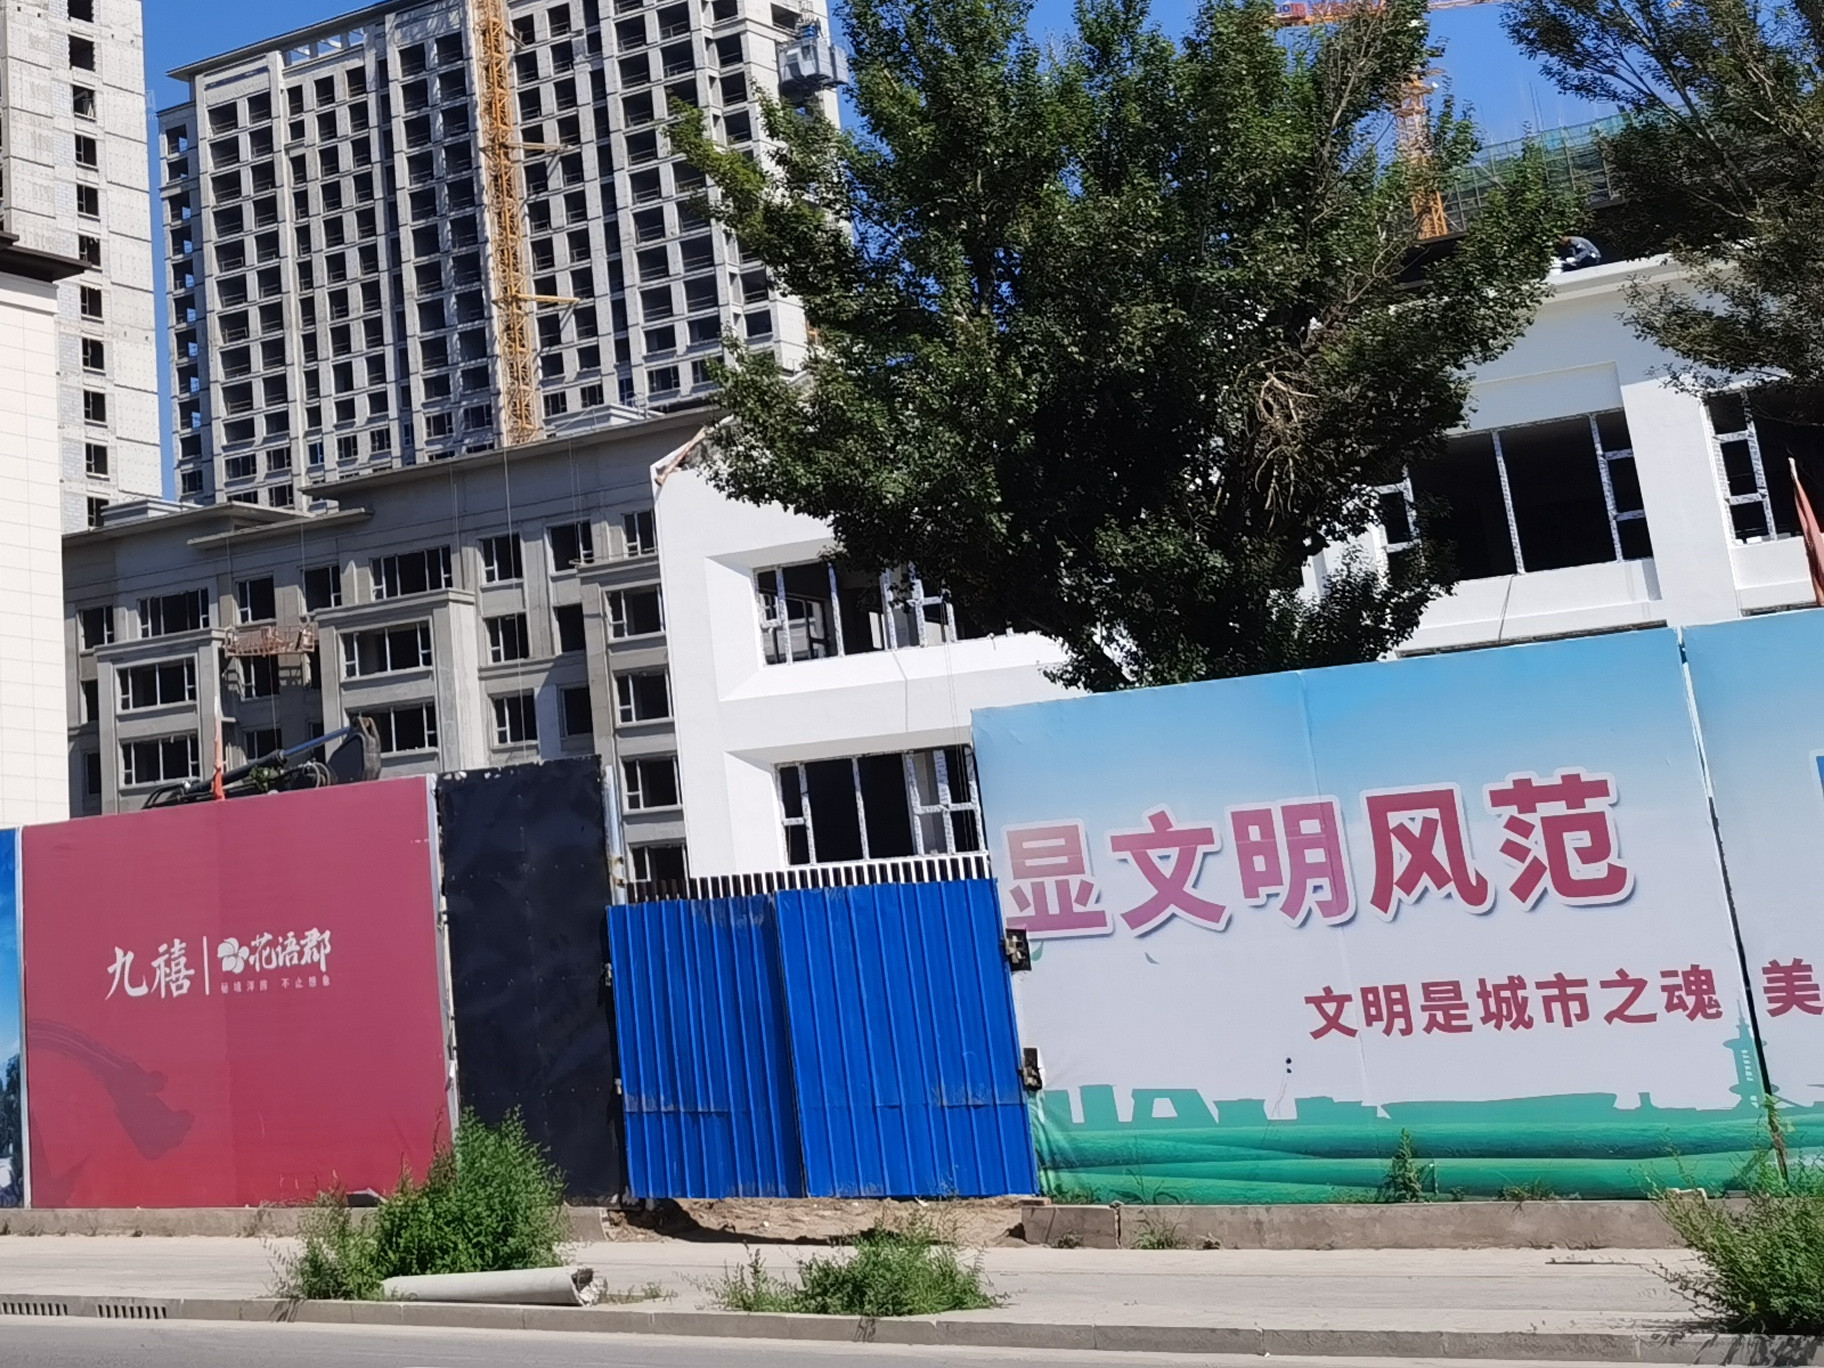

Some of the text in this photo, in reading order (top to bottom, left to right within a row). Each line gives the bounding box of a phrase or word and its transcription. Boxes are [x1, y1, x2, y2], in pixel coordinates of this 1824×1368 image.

[1005, 772, 1630, 935] 显文明风范
[105, 938, 195, 1001] 九禧
[249, 927, 331, 973] 花语郡
[1304, 957, 1824, 1040] 文明是城市之魂 美
